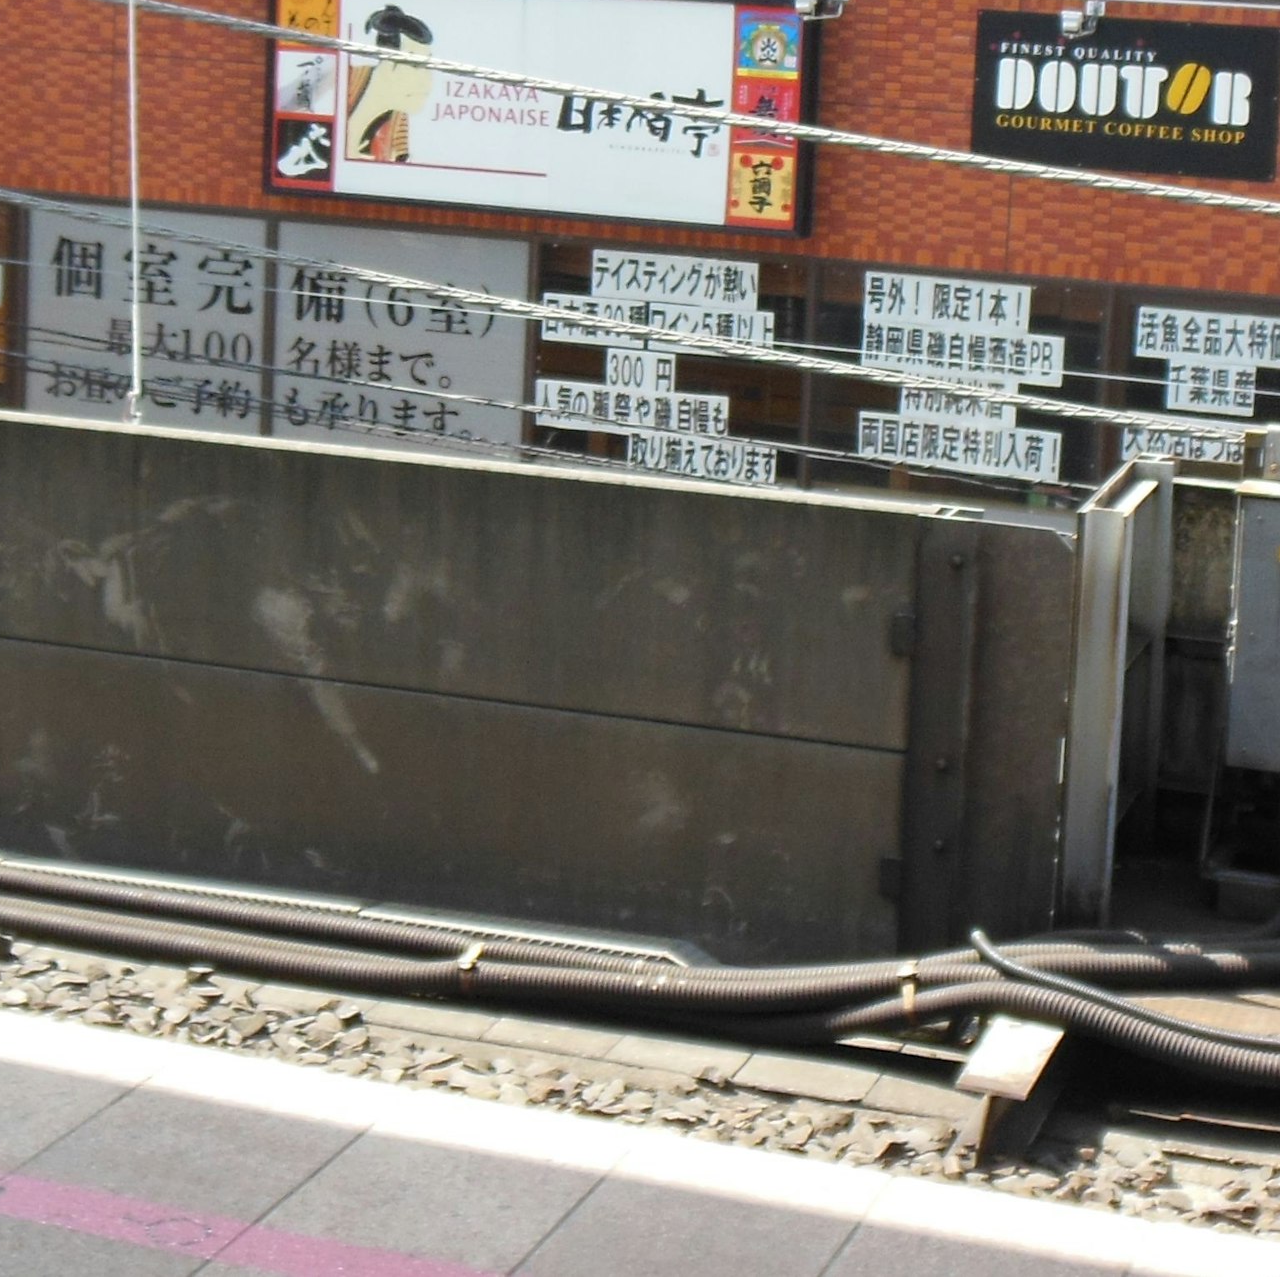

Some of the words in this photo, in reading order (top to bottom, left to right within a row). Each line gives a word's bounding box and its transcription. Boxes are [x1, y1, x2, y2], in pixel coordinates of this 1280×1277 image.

[1000, 41, 1066, 58] FINEST
[1073, 46, 1158, 64] QUALITY
[445, 80, 540, 104] IZAKAYA
[995, 56, 1253, 127] DOUTOR
[431, 102, 551, 128] JAPONAISE
[995, 113, 1097, 136] GOURMET
[1103, 120, 1184, 142] COFFEE
[1191, 128, 1246, 146] SHOP
[1170, 364, 1254, 408] 千葉県産
